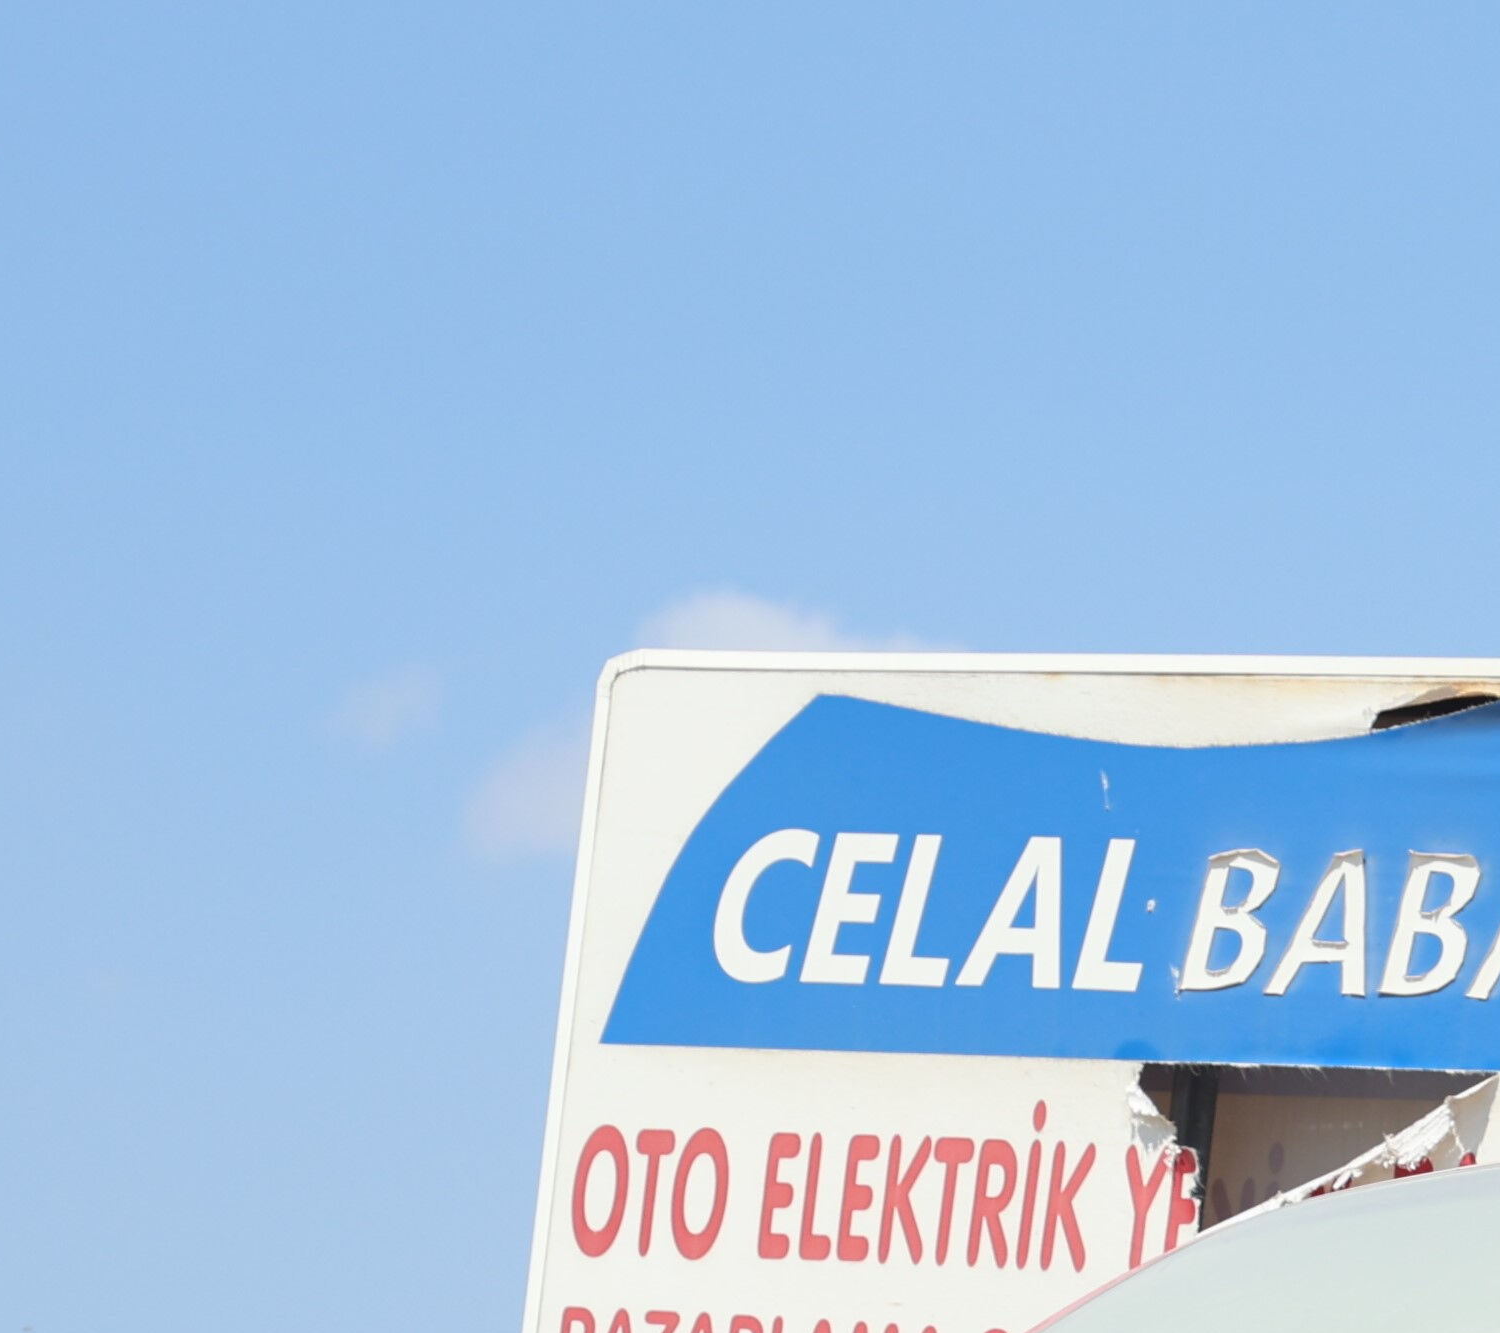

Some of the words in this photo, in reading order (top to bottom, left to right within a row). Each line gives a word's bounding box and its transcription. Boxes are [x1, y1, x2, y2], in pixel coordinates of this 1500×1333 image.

[713, 828, 1145, 992] CELAL
[571, 1124, 730, 1260] OTO
[757, 1099, 1098, 1273] ELEKTRİK
